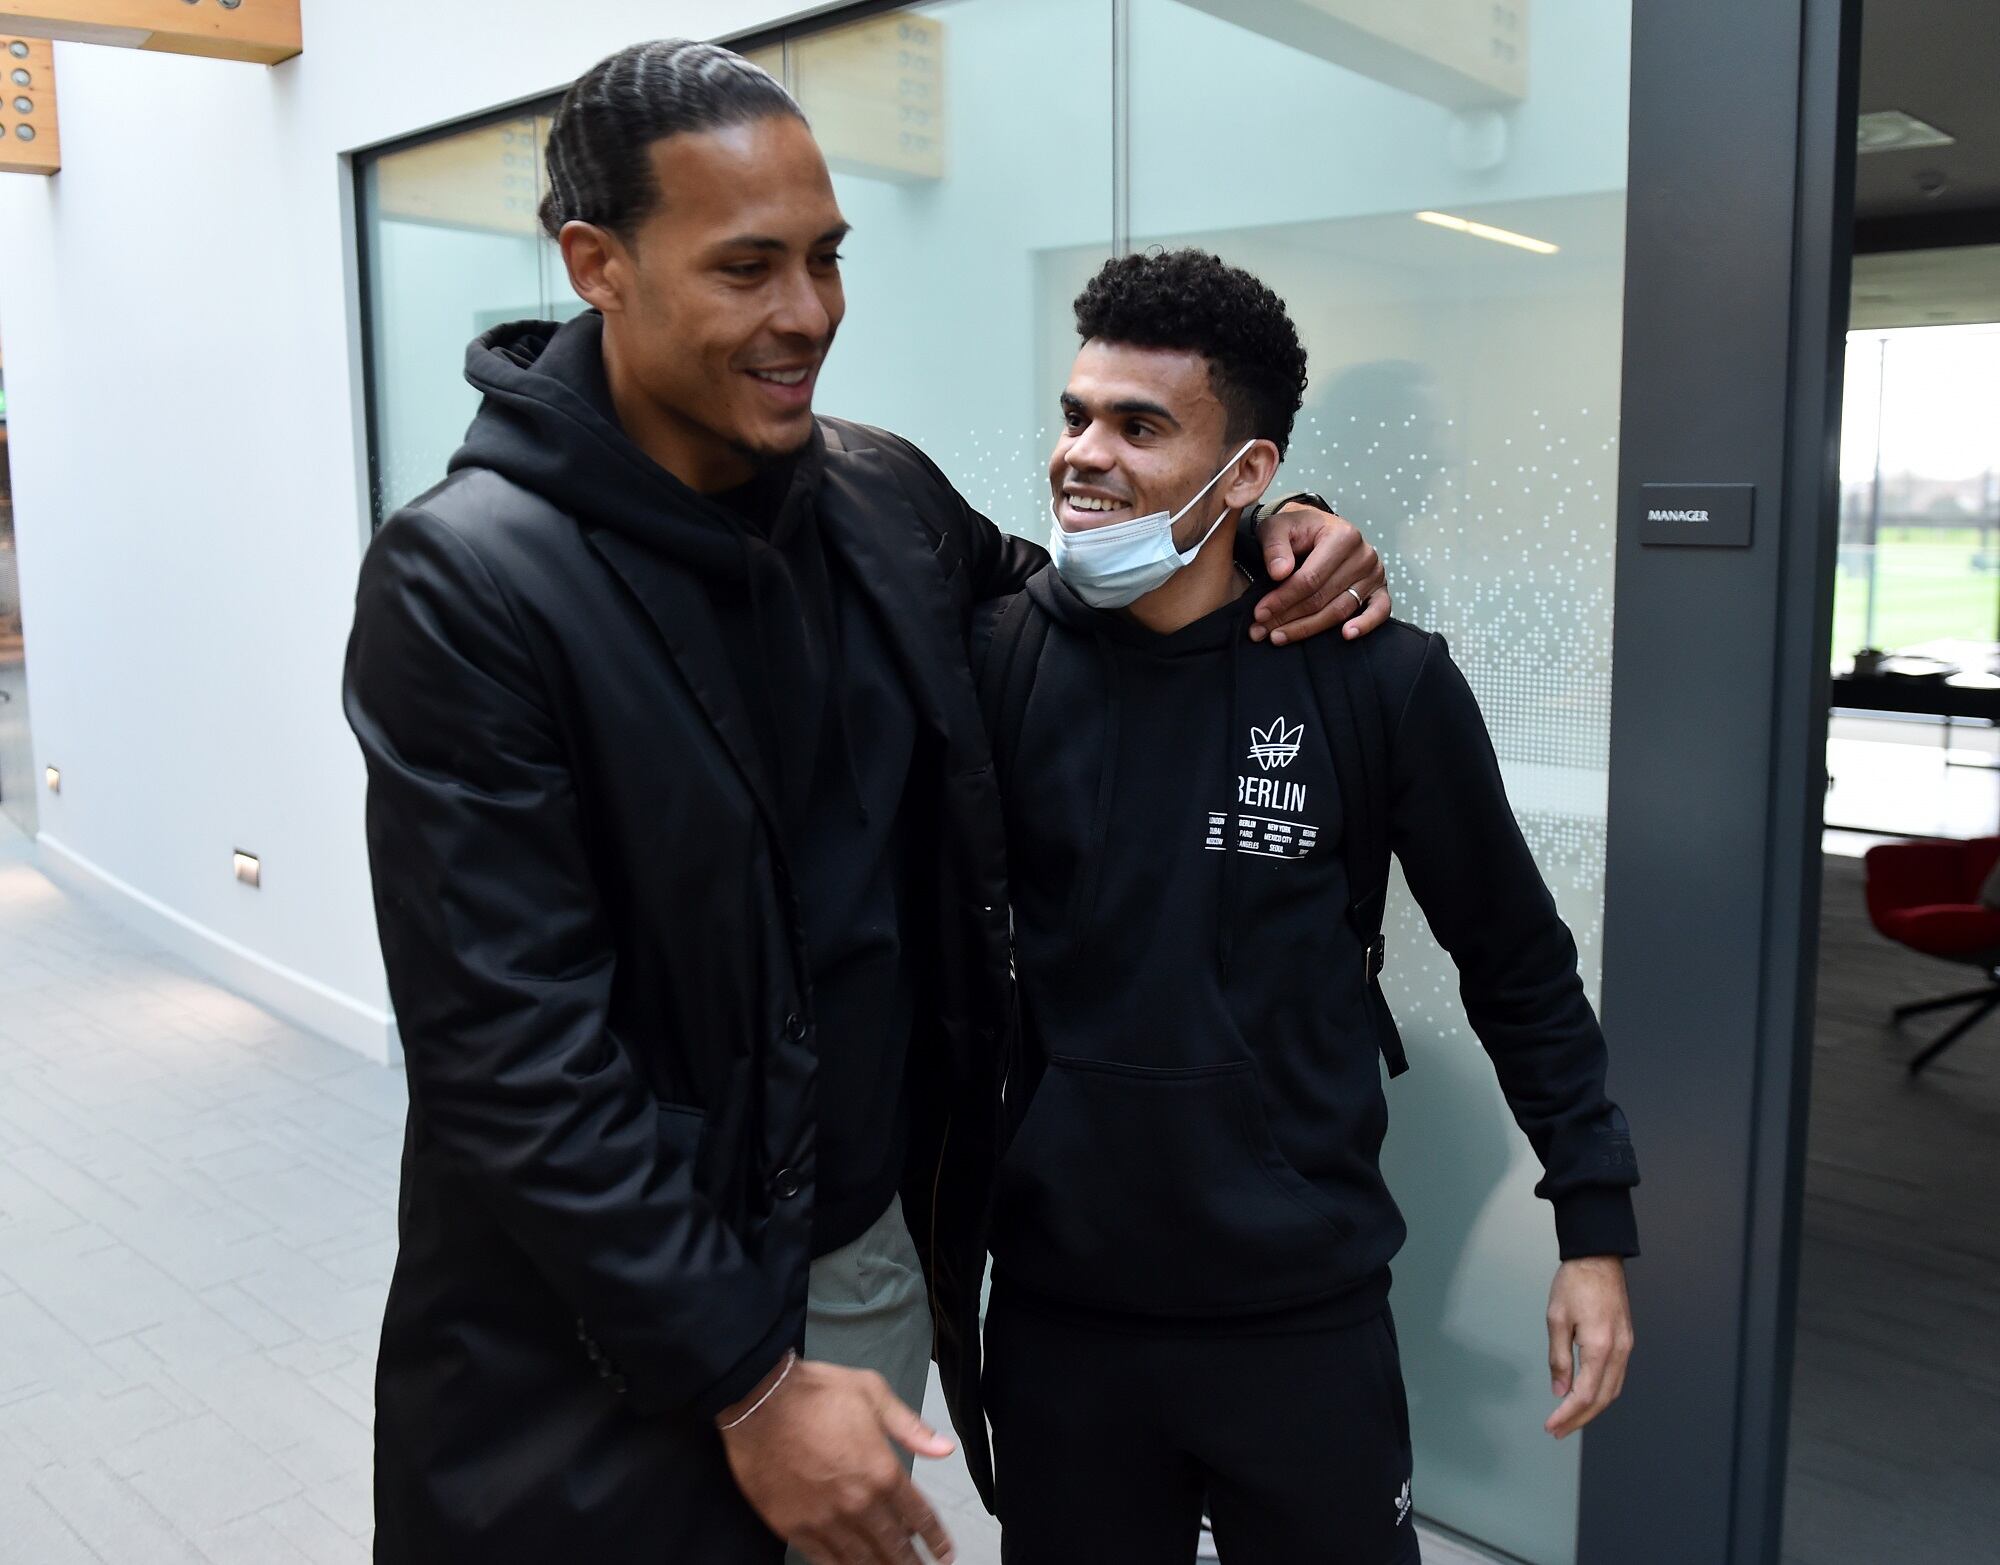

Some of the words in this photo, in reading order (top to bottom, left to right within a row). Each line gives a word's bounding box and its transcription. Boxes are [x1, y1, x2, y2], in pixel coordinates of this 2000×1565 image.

[1648, 510, 1708, 522] MANAGER
[1239, 819, 1256, 828] BERLIN
[1268, 823, 1278, 831] NEW
[1279, 825, 1291, 834] YORK
[1239, 830, 1253, 838] PARIS
[1264, 833, 1282, 842] MEXICO
[1269, 844, 1284, 853] SEOUL
